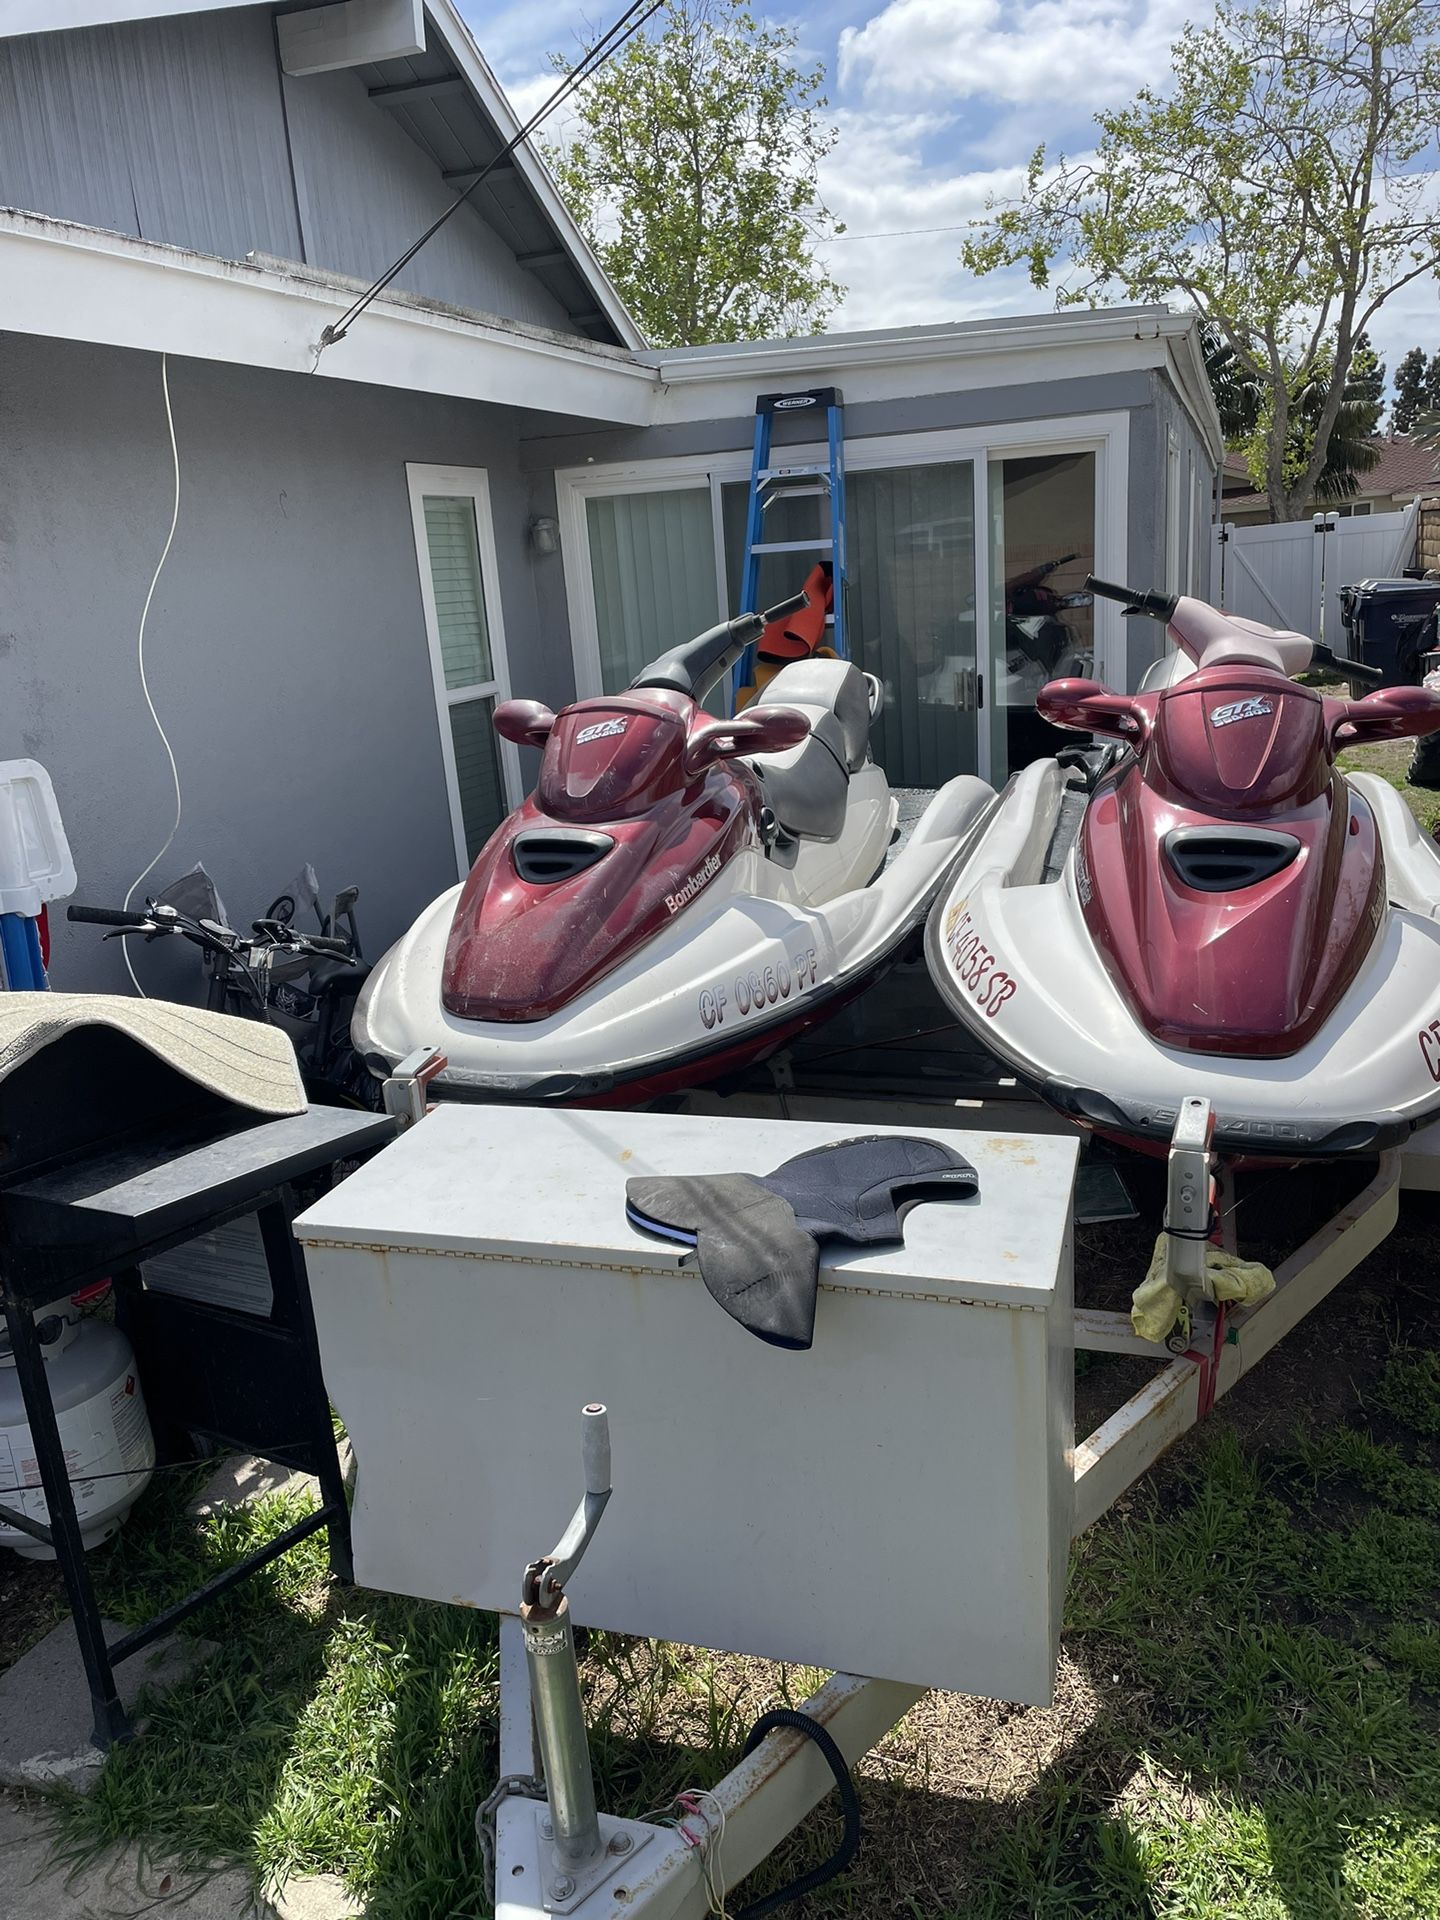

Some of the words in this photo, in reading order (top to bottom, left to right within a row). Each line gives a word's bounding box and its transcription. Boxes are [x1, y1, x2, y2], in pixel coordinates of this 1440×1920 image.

[576, 715, 628, 739] GTX
[1211, 694, 1268, 721] GTX
[664, 853, 722, 914] Bombardier
[698, 985, 727, 1030] CF
[734, 960, 791, 1016] 0860
[794, 948, 818, 991] PF
[952, 929, 995, 992] 4058
[977, 971, 1017, 1018] SB
